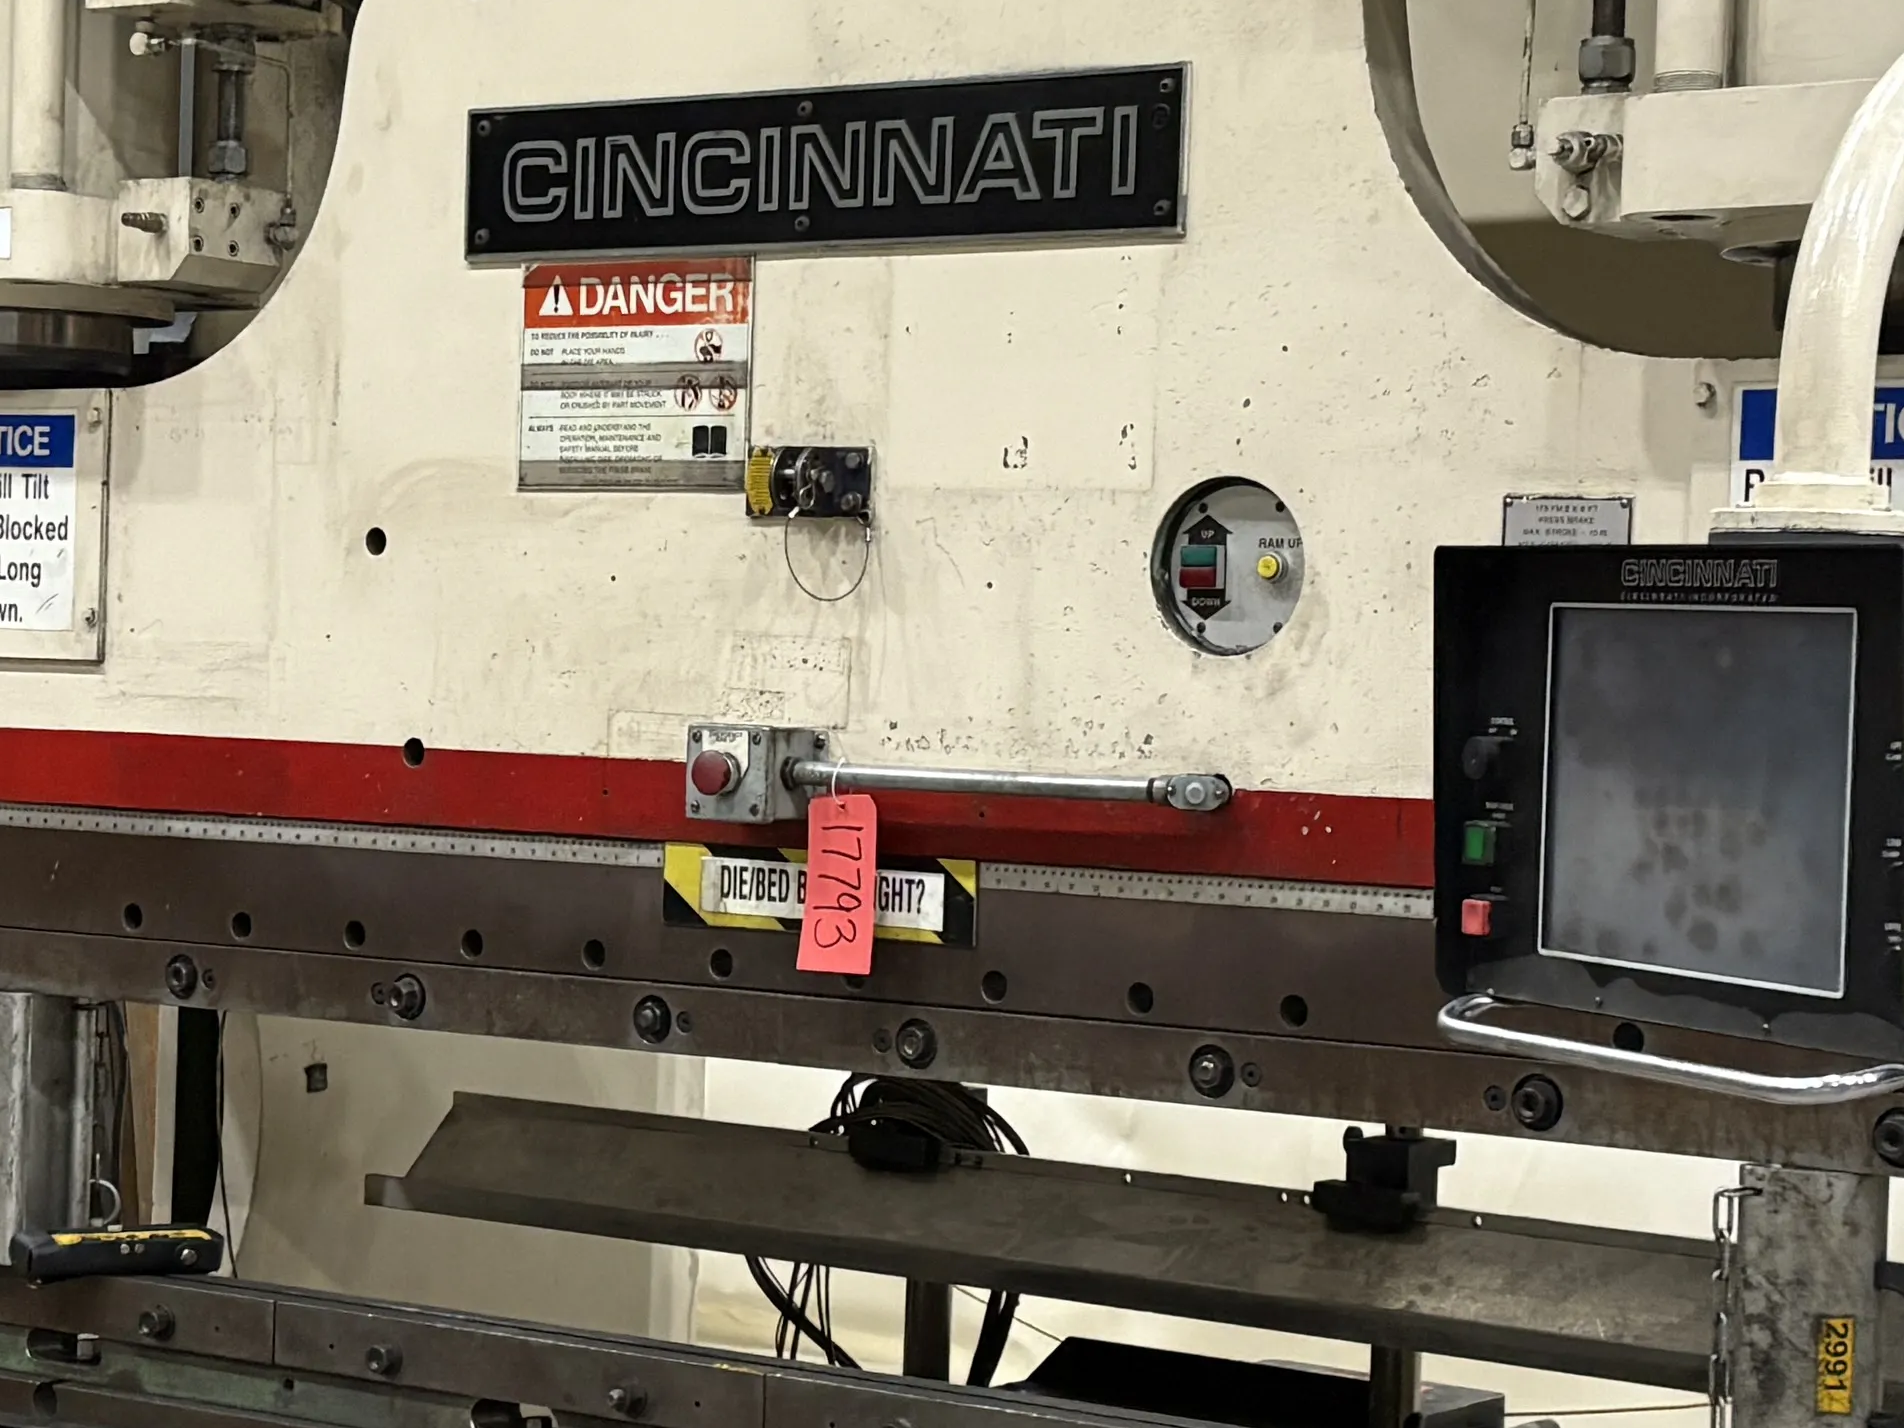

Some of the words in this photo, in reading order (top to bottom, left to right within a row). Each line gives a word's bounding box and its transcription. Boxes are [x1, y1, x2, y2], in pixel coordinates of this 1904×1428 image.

[503, 105, 1140, 223] CINCINNATI
[580, 272, 734, 316] DANGER
[21, 473, 50, 500] Tilt
[1200, 530, 1215, 539] UP
[1259, 537, 1284, 549] RAM
[1621, 559, 1778, 588] CINCINNATI
[1192, 597, 1220, 606] DOWN
[720, 864, 790, 903] DIE/BED
[813, 825, 864, 949] 17793
[1824, 1322, 1849, 1391] 2991
